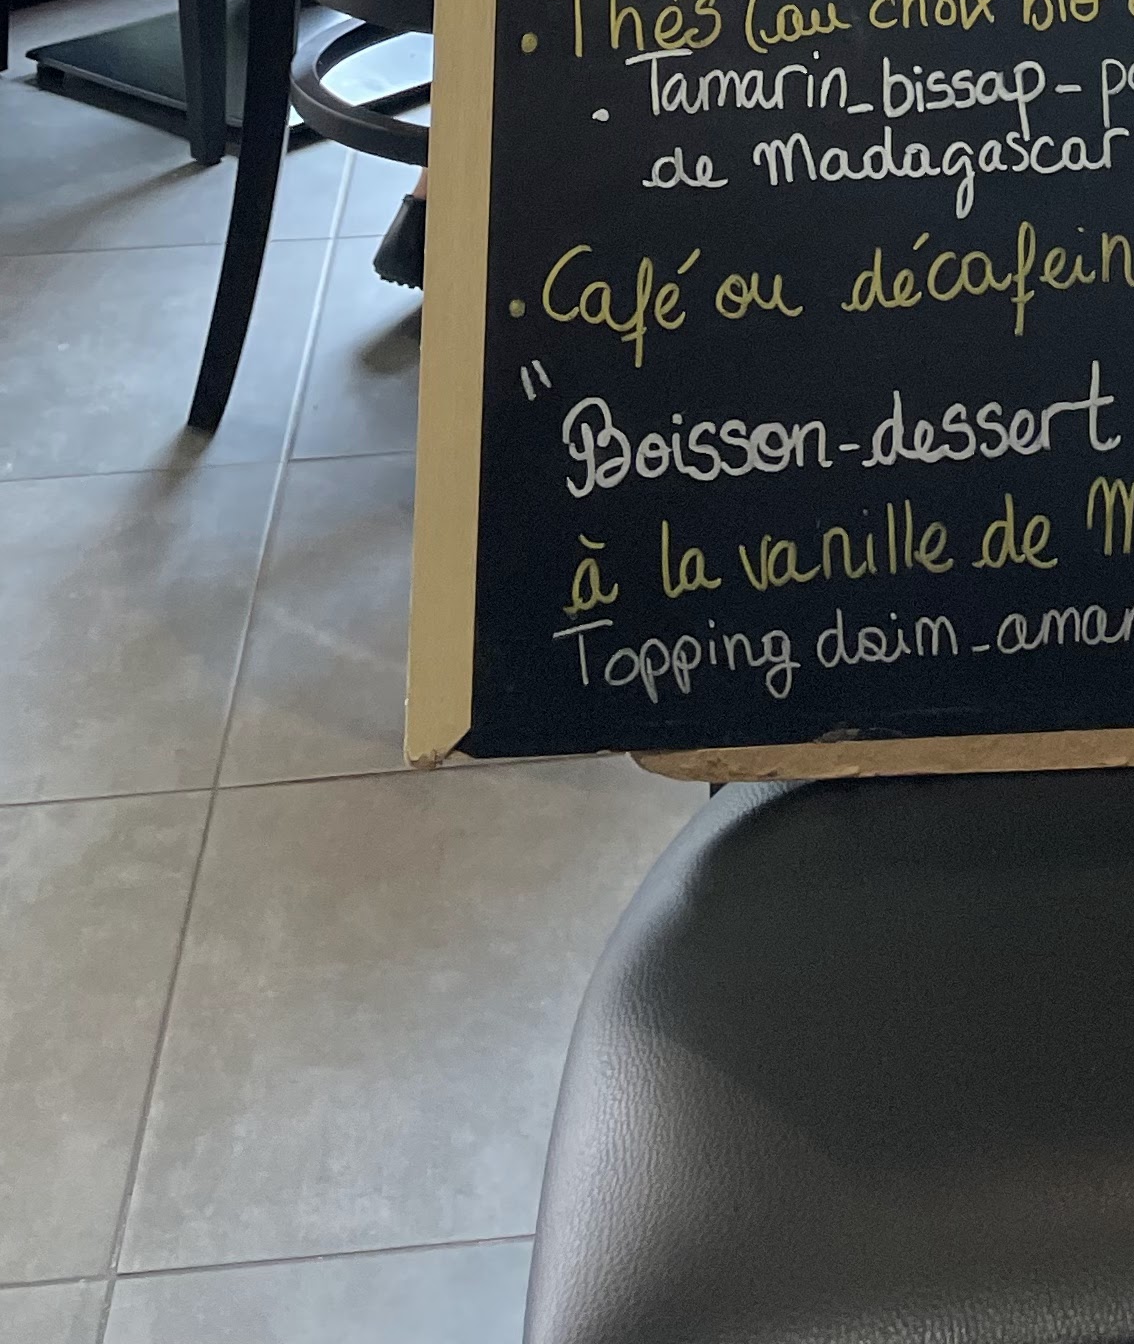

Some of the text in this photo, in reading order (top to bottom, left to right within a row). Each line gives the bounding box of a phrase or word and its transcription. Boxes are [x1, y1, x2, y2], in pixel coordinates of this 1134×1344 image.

[641, 125, 1130, 220] de Madagascar
[542, 244, 701, 369] Café
[715, 272, 804, 320] ou
[661, 519, 722, 599] la
[738, 499, 954, 591] vanille
[971, 492, 1059, 569] de
[552, 618, 802, 704] Topping
